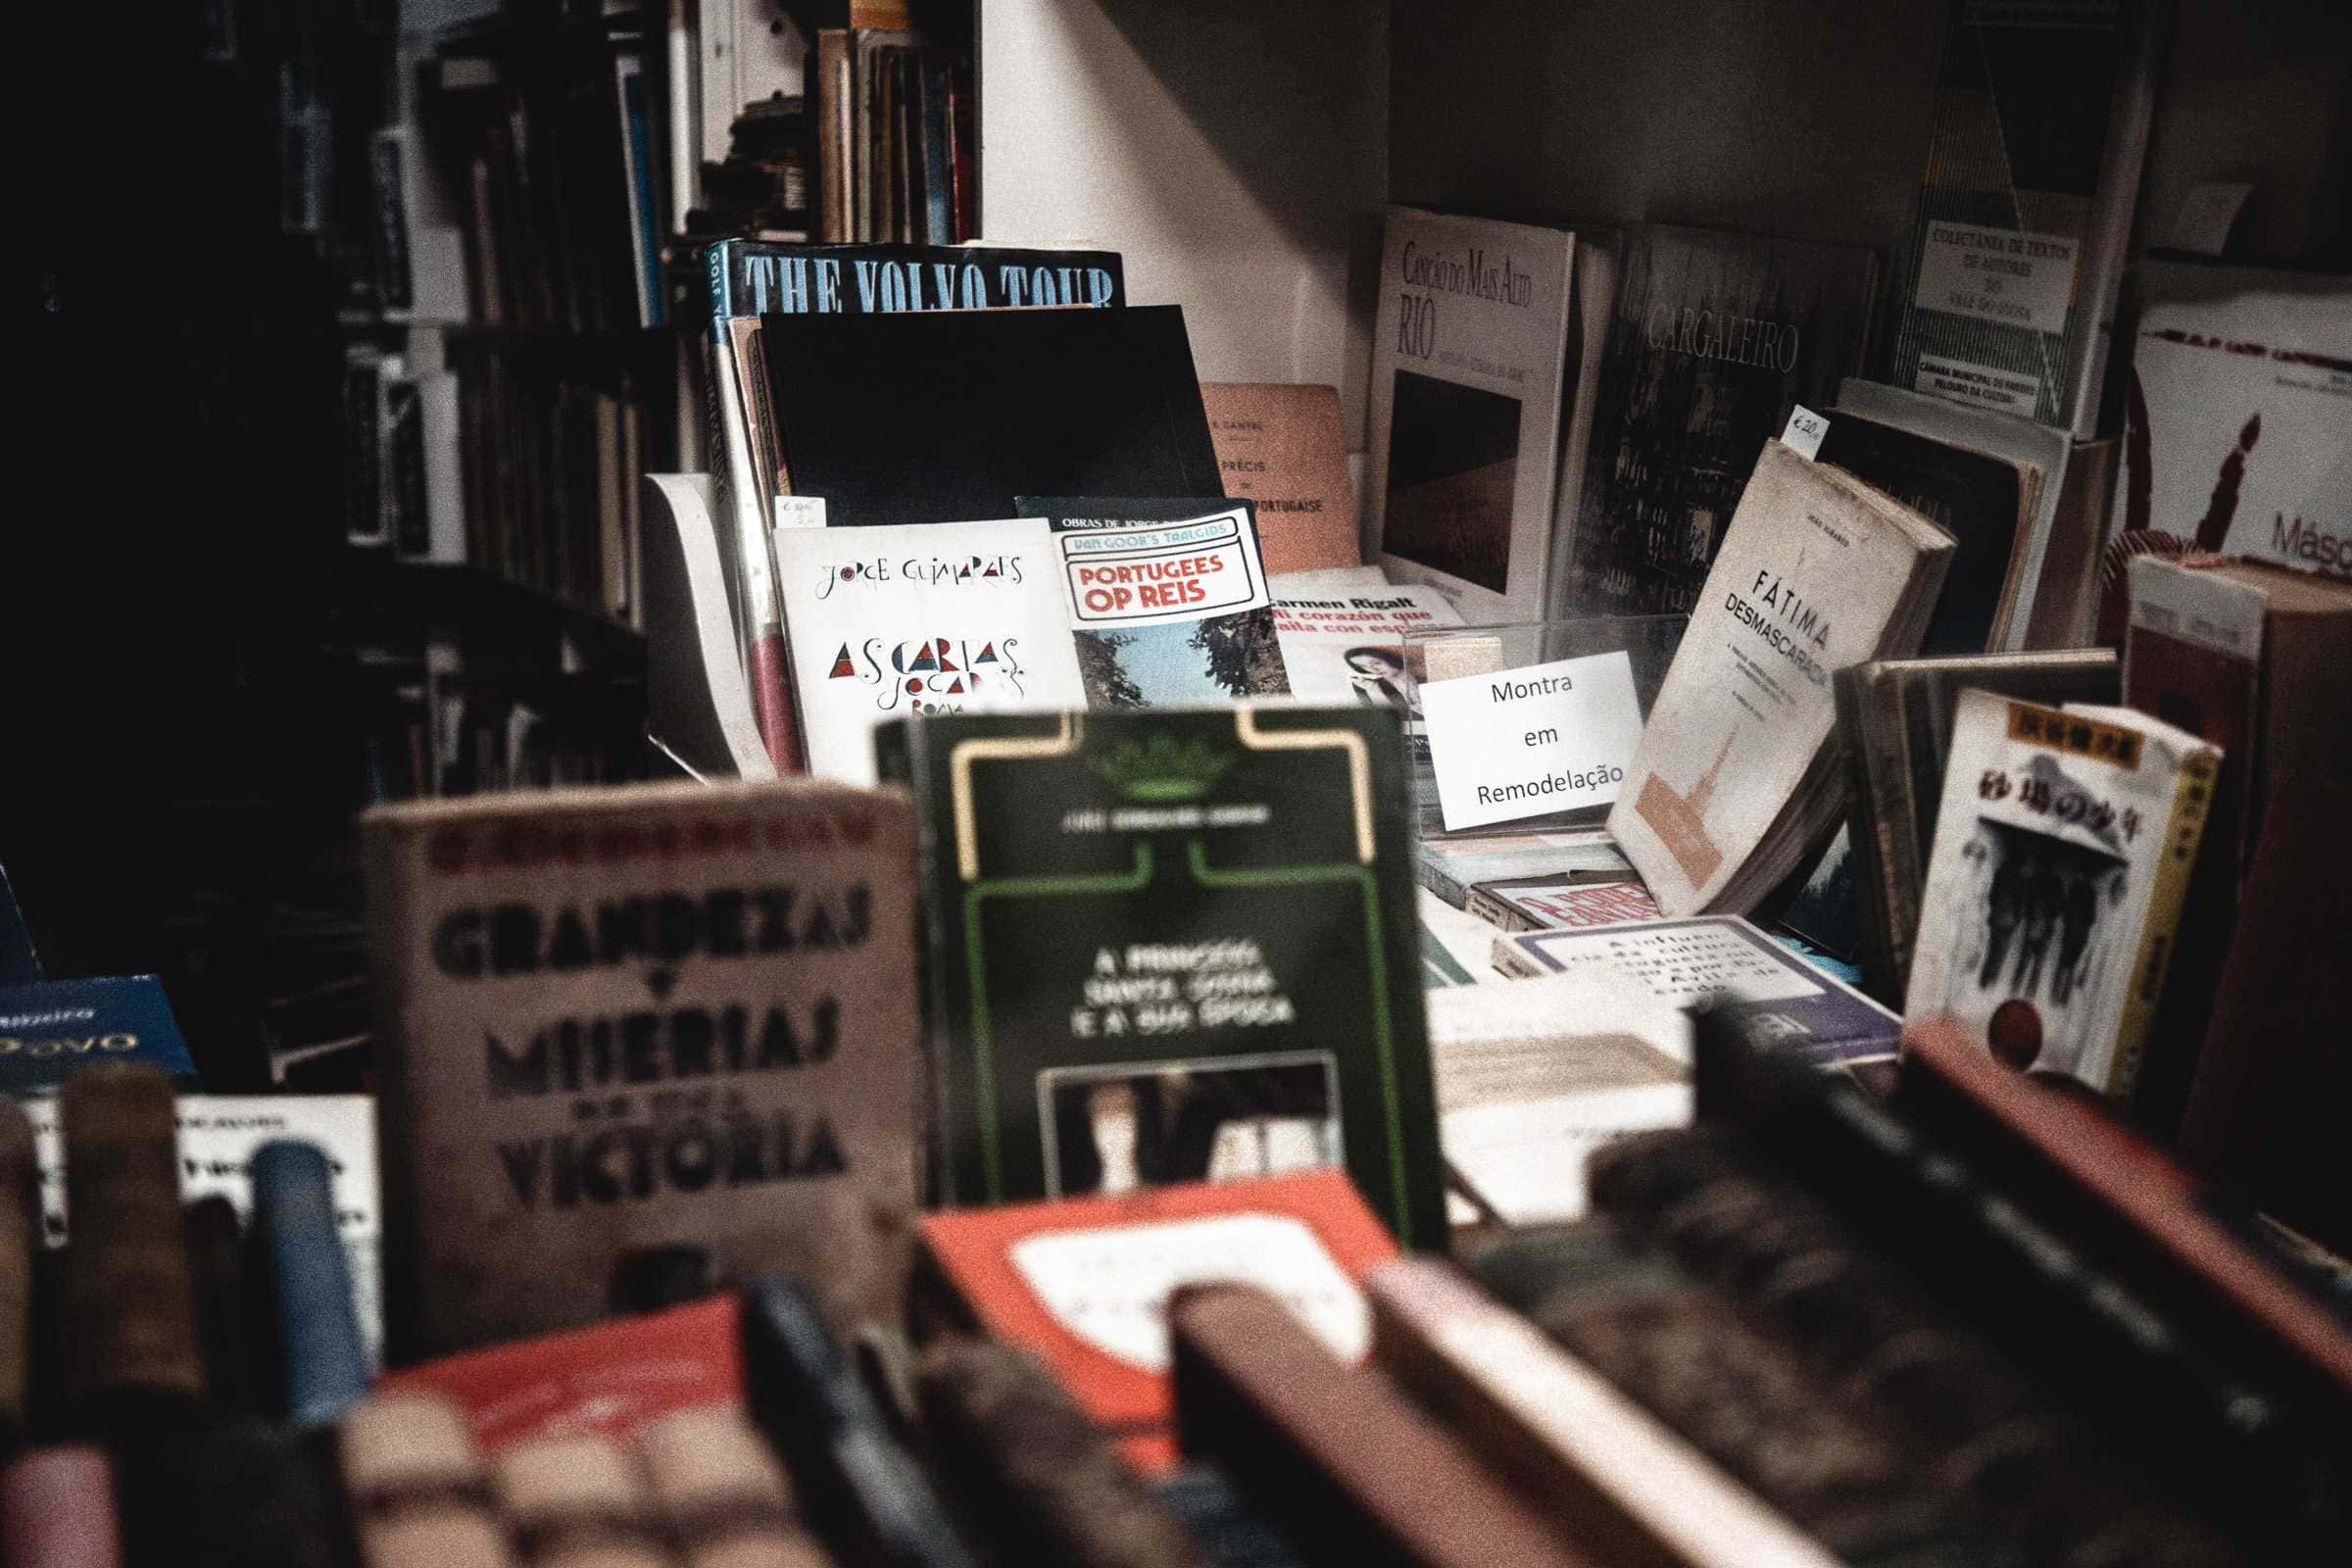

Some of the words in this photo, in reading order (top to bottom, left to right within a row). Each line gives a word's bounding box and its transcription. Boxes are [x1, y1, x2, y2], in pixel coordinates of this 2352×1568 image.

[745, 255, 842, 314] THE
[855, 259, 987, 313] VOLVO
[1000, 265, 1113, 309] TOUR
[1396, 294, 1435, 360] RIO
[1648, 307, 1799, 374] CARGALEIRO
[1062, 517, 1102, 529] OBRAS
[1079, 555, 1224, 586] PORTUGEES
[1084, 588, 1132, 612] OP
[1139, 579, 1206, 609] REIS
[1348, 597, 1416, 611] Rigalt
[1752, 569, 1831, 651] FÁTIMA
[1276, 621, 1318, 633] aila
[1323, 623, 1364, 634] con
[1298, 610, 1385, 621] corazón
[1392, 612, 1433, 624] que
[1491, 675, 1573, 703] Montra
[1524, 727, 1558, 747] em
[1477, 763, 1624, 806] Remodelação
[496, 1115, 851, 1209] VICTORIA
